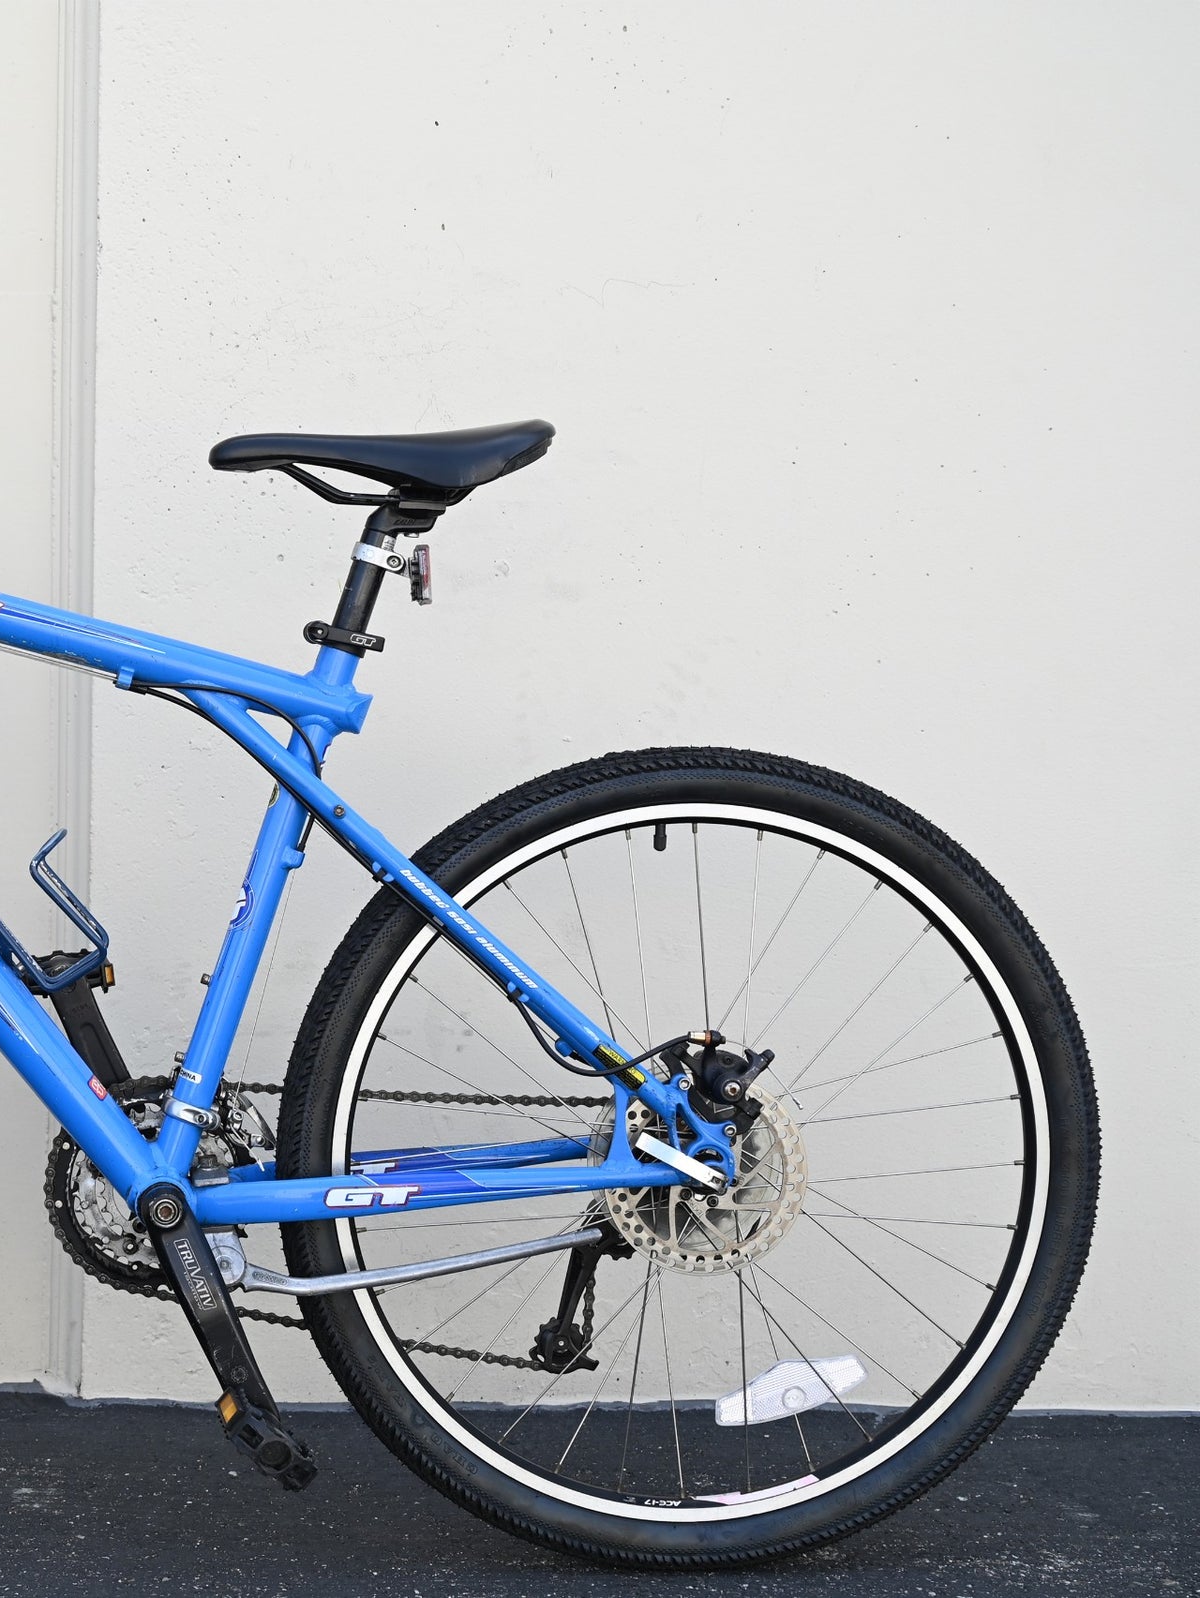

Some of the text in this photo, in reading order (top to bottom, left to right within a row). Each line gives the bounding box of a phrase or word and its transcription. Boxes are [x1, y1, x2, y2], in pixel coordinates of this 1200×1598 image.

[350, 632, 377, 647] GT
[324, 1186, 420, 1207] GT
[175, 1239, 216, 1308] TRUVATIV
[643, 1498, 682, 1508] ACC-17
